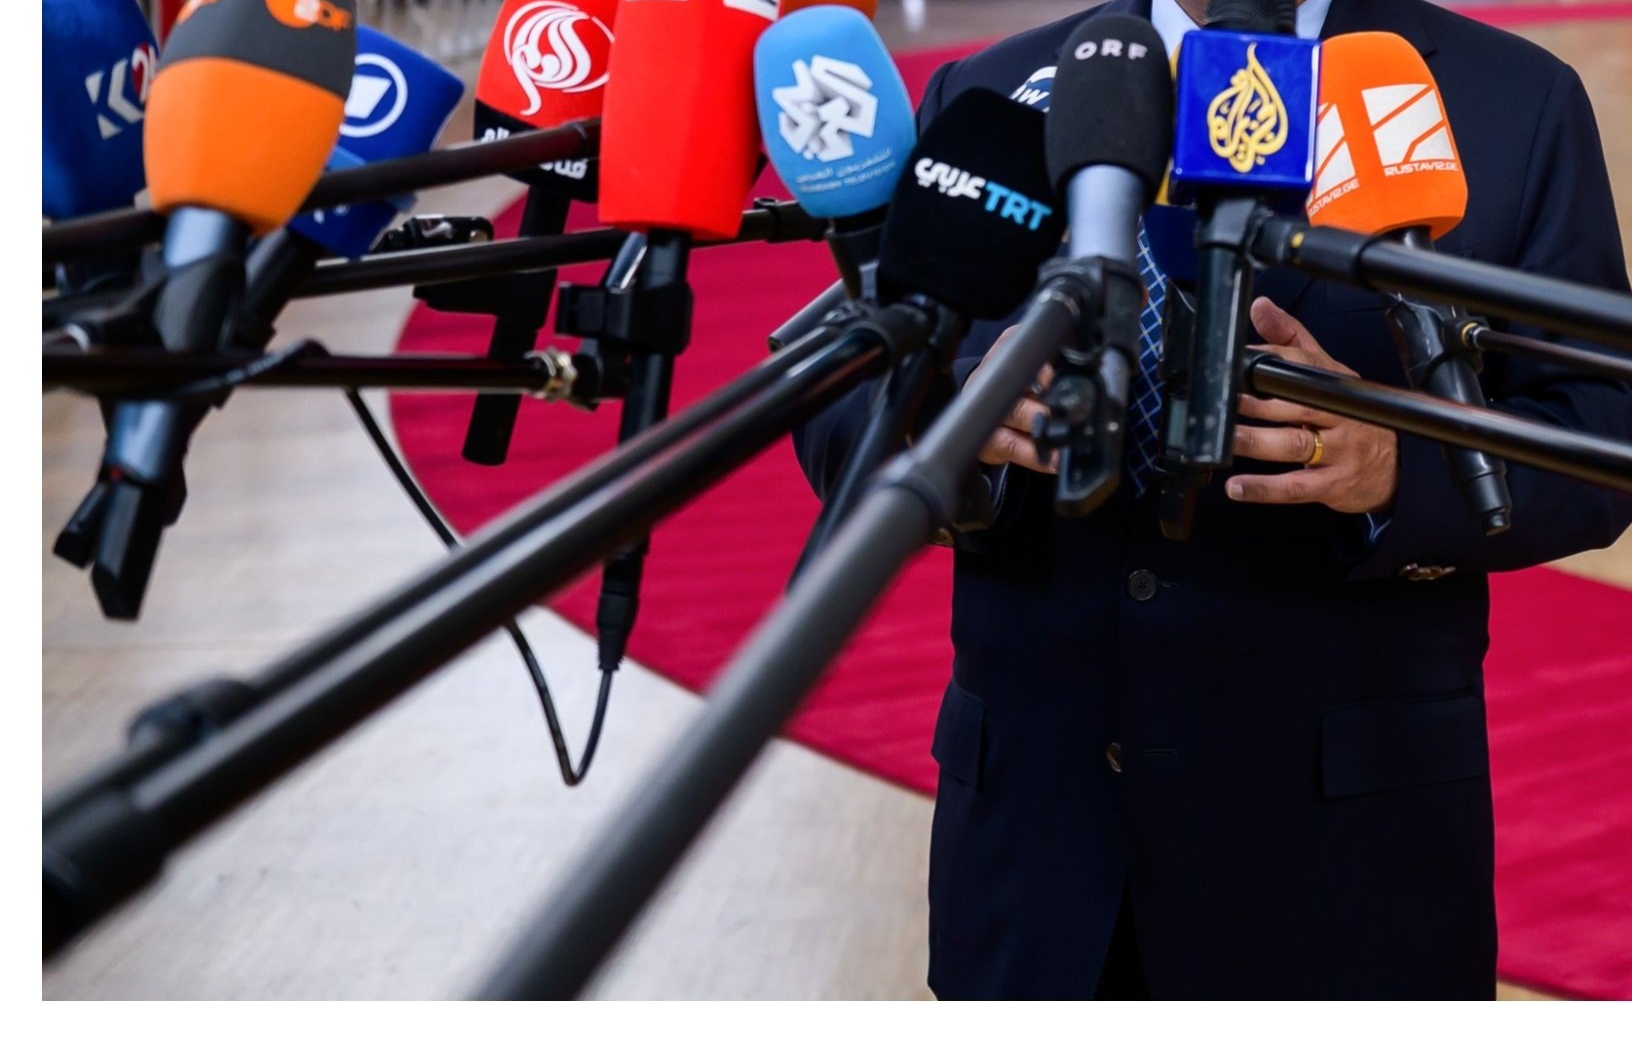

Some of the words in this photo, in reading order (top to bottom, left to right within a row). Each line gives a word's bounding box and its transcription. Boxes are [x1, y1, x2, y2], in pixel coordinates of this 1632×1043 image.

[1074, 38, 1148, 60] ORF
[914, 157, 986, 200] عربي
[985, 180, 1053, 231] TRT
